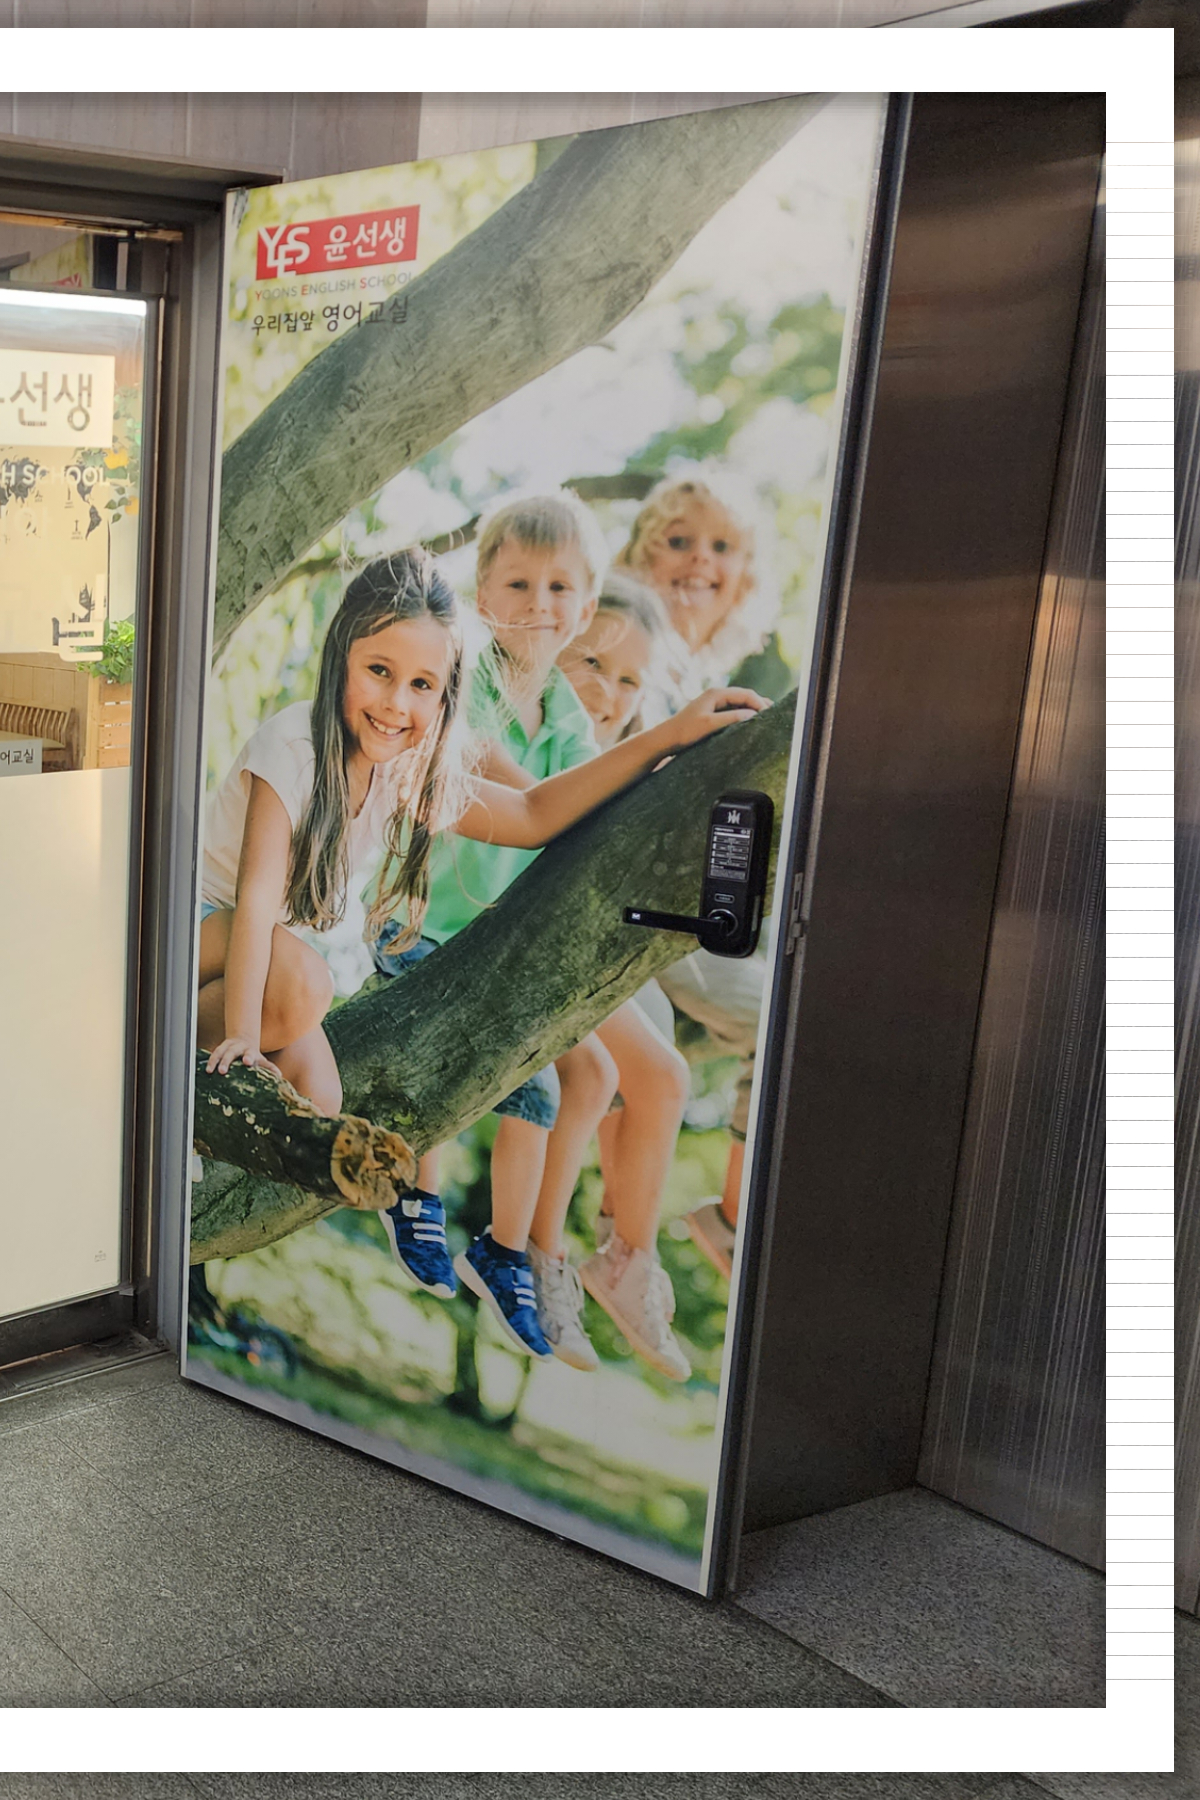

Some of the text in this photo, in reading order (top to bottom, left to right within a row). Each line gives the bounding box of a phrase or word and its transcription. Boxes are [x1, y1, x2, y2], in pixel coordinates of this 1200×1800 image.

[258, 216, 407, 278] YES 윤선생
[255, 272, 413, 301] YOONS ENGLISH SCHOOL
[251, 296, 409, 336] 우리집앞 영어교실
[22, 465, 110, 488] SCHOOL
